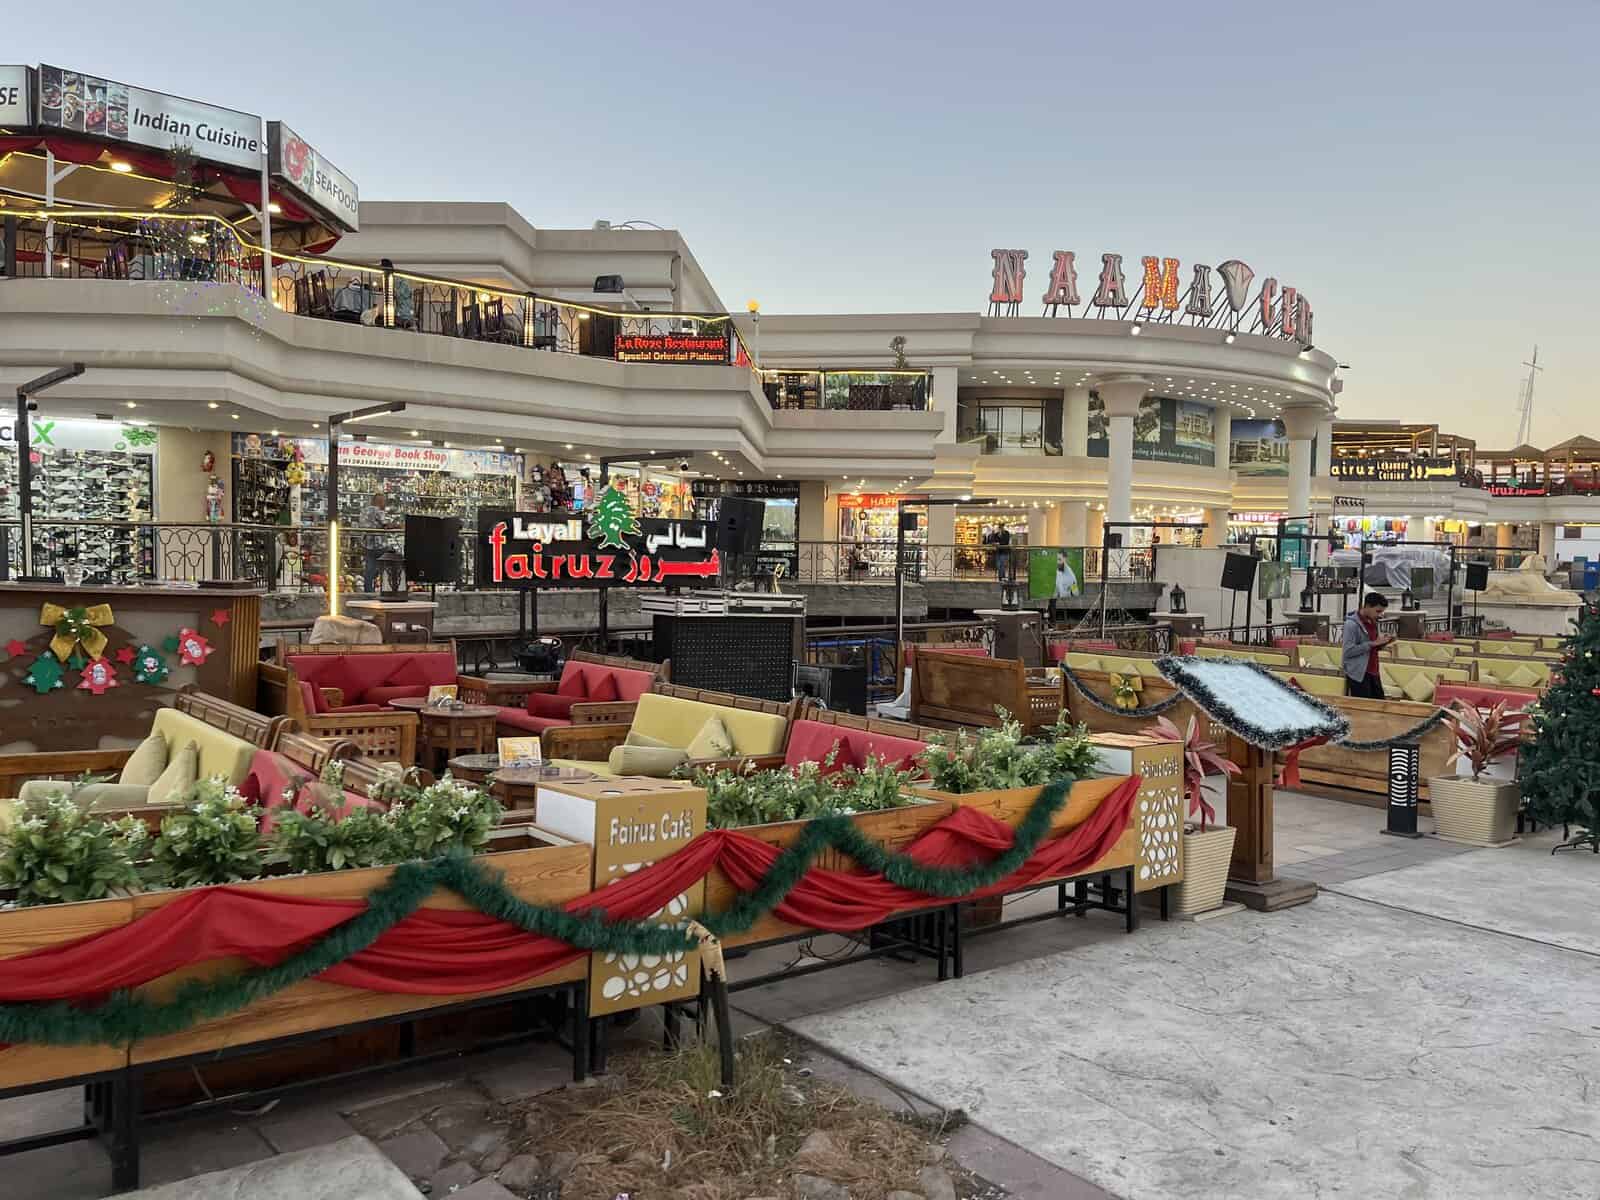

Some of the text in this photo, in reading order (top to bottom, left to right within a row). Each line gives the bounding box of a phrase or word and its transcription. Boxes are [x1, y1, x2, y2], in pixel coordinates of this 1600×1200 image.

[133, 108, 258, 152] Indian Cuisine
[315, 171, 357, 212] SEAFOOD
[991, 249, 1213, 317] NAAMA
[618, 336, 724, 350] La Rose Restaurant
[353, 446, 391, 460] George
[395, 448, 421, 460] Book
[423, 448, 448, 464] Shop
[1331, 461, 1375, 475] airuz
[870, 497, 899, 505] HAPP
[513, 517, 582, 544] Layali
[646, 523, 706, 554] ليالي
[489, 521, 616, 582] fairuz
[622, 548, 720, 583] فيروز
[609, 816, 656, 846] Fairuz
